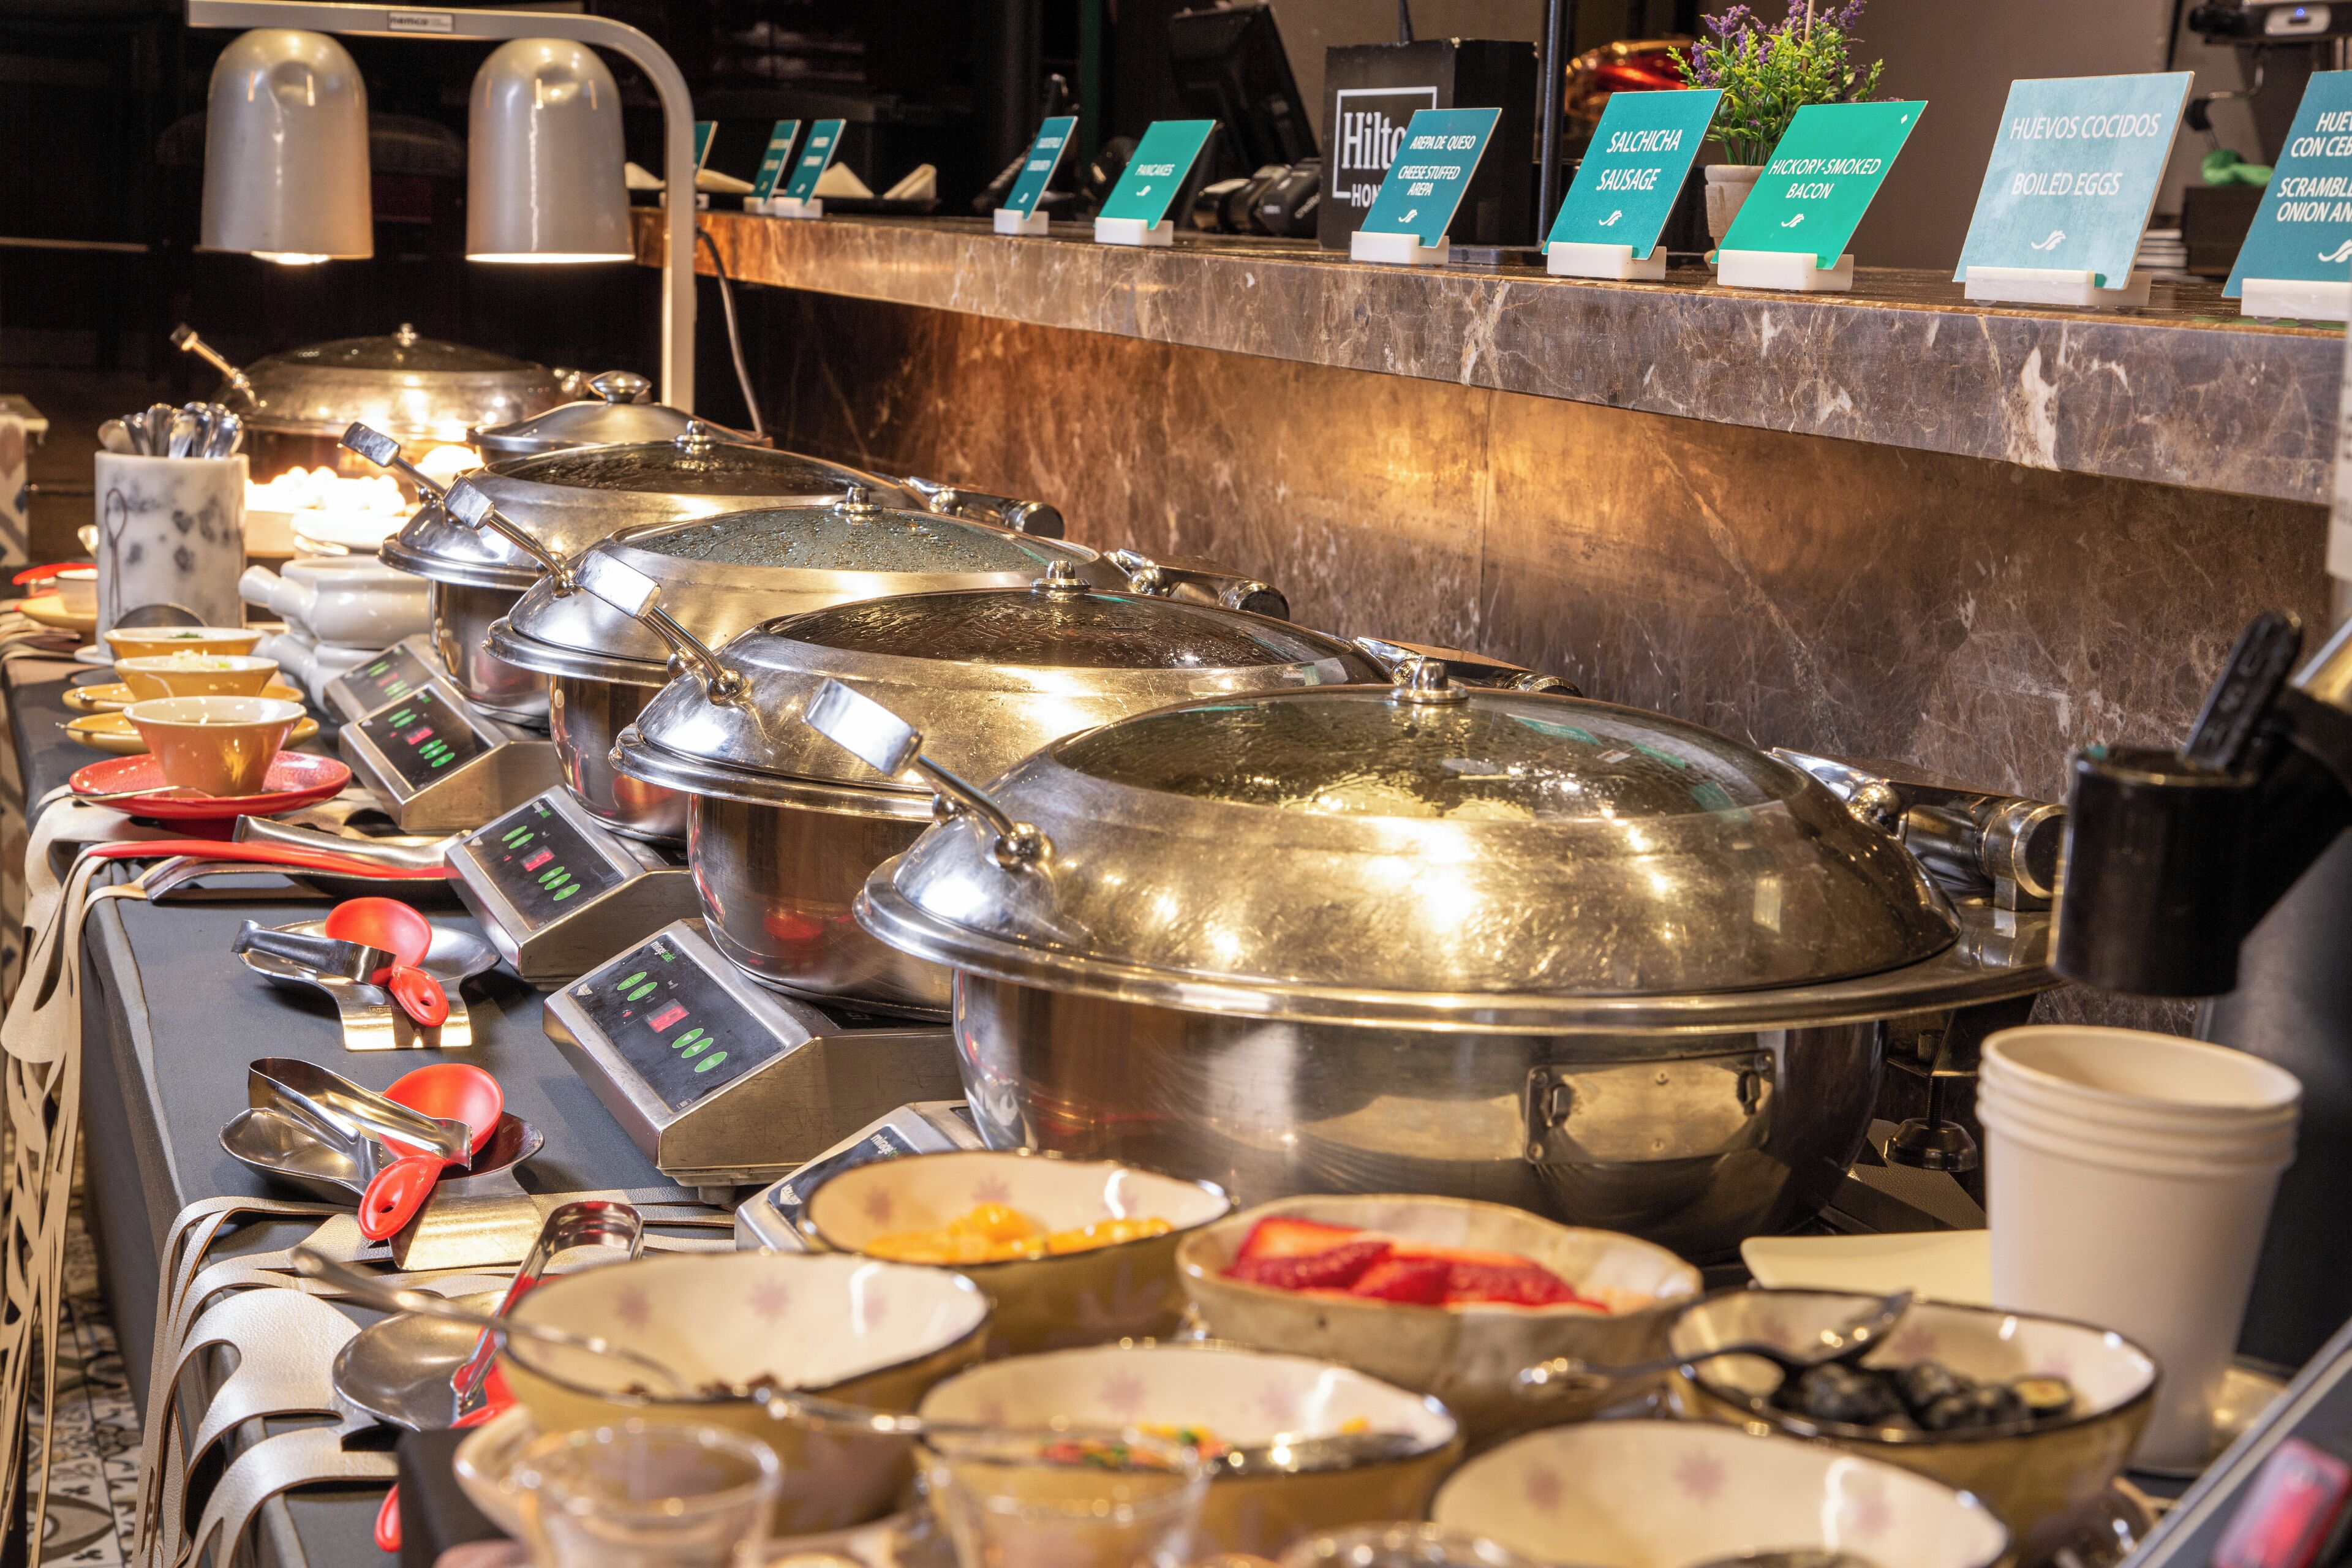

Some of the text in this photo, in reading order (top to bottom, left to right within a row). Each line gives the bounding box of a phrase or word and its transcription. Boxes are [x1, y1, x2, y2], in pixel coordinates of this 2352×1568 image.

[2010, 113, 2162, 140] HUEVOS COCIDOS
[1409, 135, 1476, 151] AREPA DE QUESO
[1607, 129, 1683, 153] SALCHICHA
[2291, 137, 2326, 157] CON
[1398, 165, 1461, 179] CHEESE STUFFED
[1768, 158, 1882, 175] HICKORY-SMOKED
[1596, 168, 1662, 190] SAUSAGE
[2011, 172, 2123, 196] BOILED EGGS
[1407, 183, 1434, 196] AREPA
[1785, 183, 1834, 199] BACON
[2277, 202, 2331, 222] ONION
[870, 1134, 894, 1155] mirage
